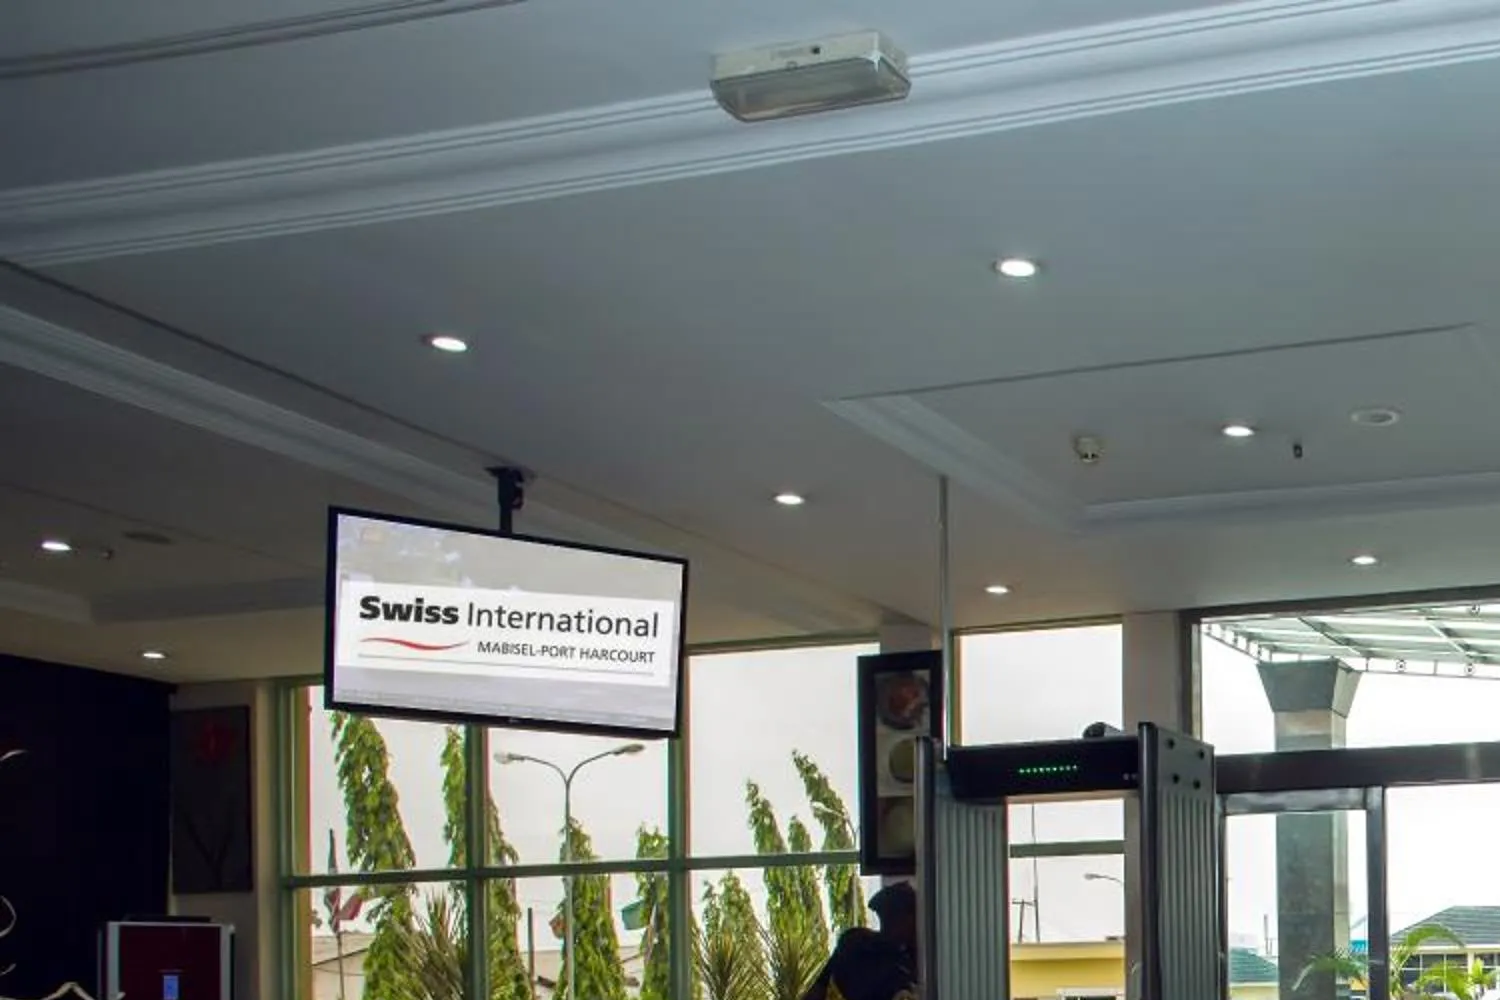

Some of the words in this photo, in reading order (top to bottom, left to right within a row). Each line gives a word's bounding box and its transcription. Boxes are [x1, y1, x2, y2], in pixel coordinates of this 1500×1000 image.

[359, 595, 459, 624] Swiss
[467, 601, 658, 638] International
[477, 640, 576, 659] MABISEL-PORT
[579, 647, 656, 663] HARCOURT
